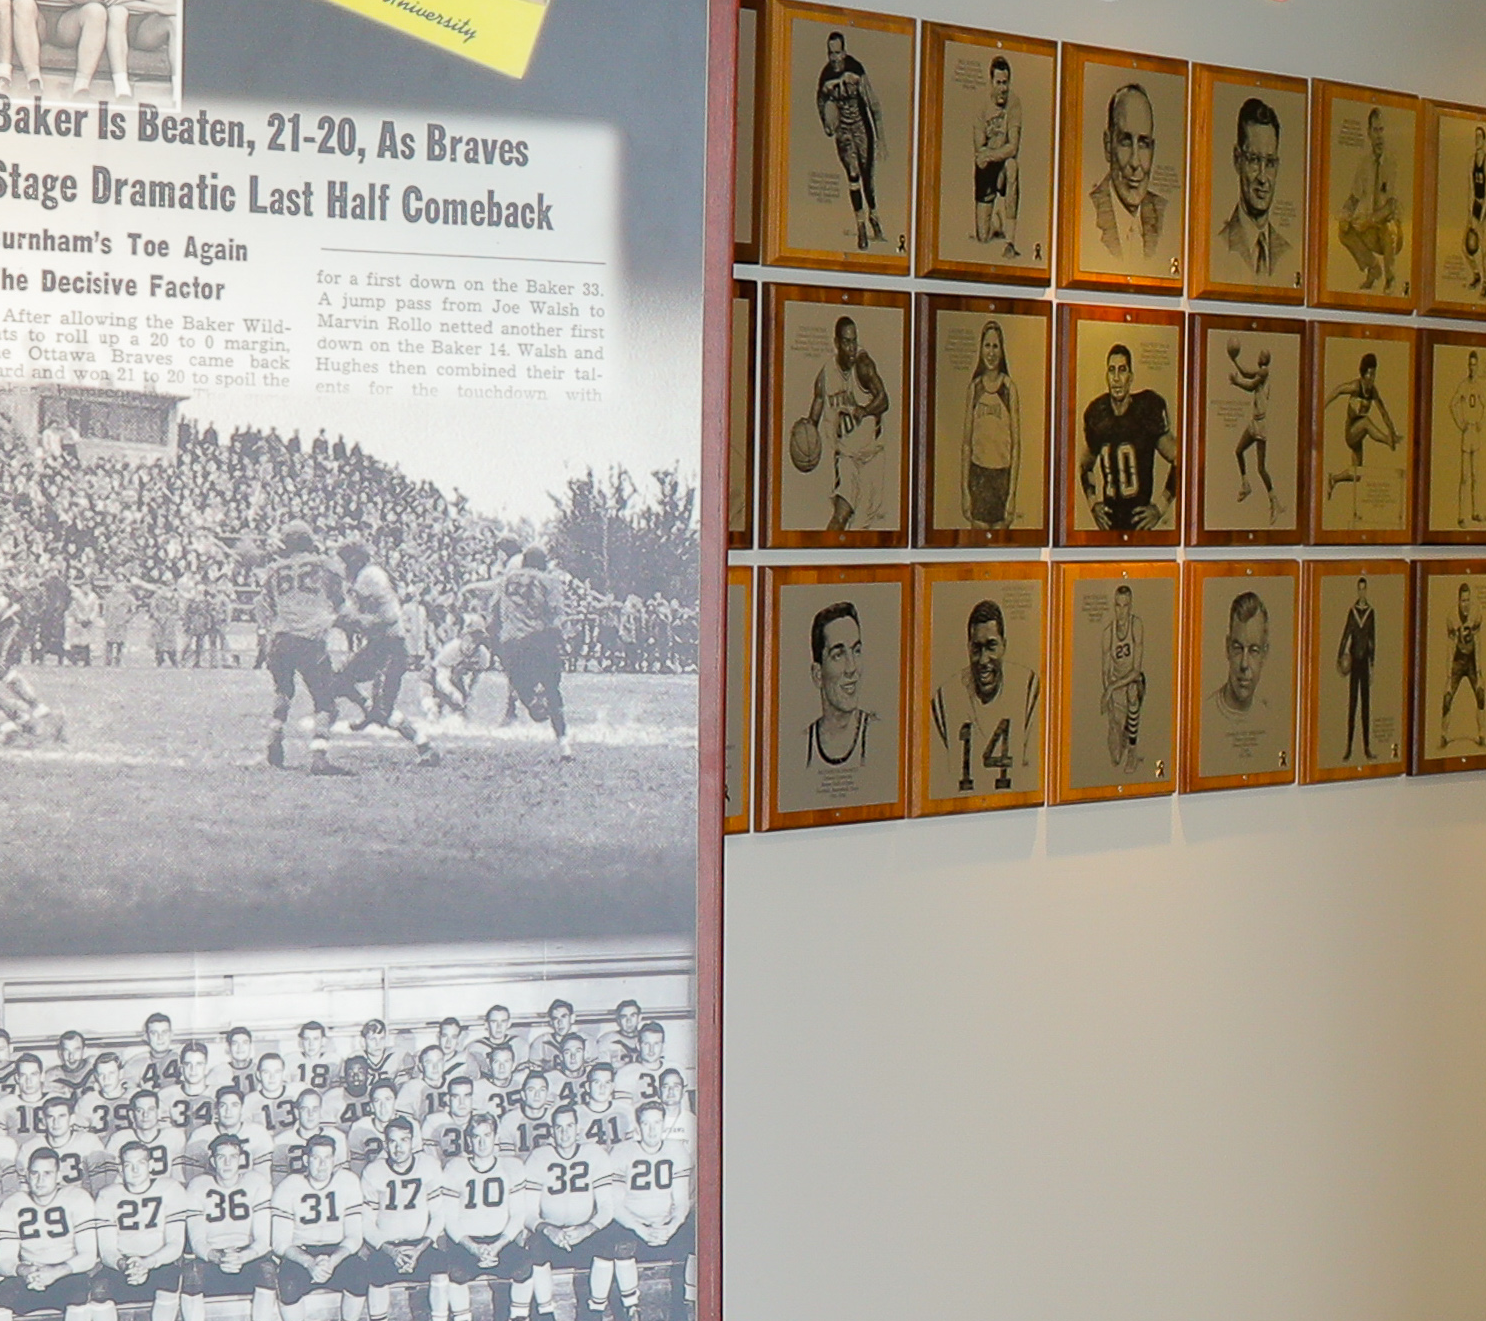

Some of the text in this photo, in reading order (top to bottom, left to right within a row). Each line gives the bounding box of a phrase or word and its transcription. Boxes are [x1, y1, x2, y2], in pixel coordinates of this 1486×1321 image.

[98, 102, 126, 142] Is
[137, 104, 255, 159] Beaten,
[267, 112, 365, 166] 21-20,
[376, 119, 415, 160] As
[426, 122, 528, 167] Braves
[92, 167, 235, 214] Dramatic
[249, 176, 313, 218] Last
[327, 180, 389, 222] Half
[402, 184, 552, 231] Comeback
[131, 232, 169, 258] Toe
[184, 235, 247, 267] Again
[41, 269, 136, 297] Decisive
[150, 273, 225, 300] Factor
[316, 270, 603, 296] for a first down on the Baker 33.
[2, 309, 291, 335] After allowing the Baker Wild-
[1101, 443, 1141, 498] 10
[1115, 644, 1131, 659] 23
[958, 718, 1013, 792] 14
[547, 1161, 589, 1195] 32
[630, 1159, 673, 1191] 20
[206, 1189, 251, 1223] 36
[299, 1190, 340, 1225] 31
[385, 1178, 422, 1210] 17
[464, 1178, 504, 1209] 10
[17, 1206, 70, 1240] 29
[117, 1197, 162, 1231] 27
